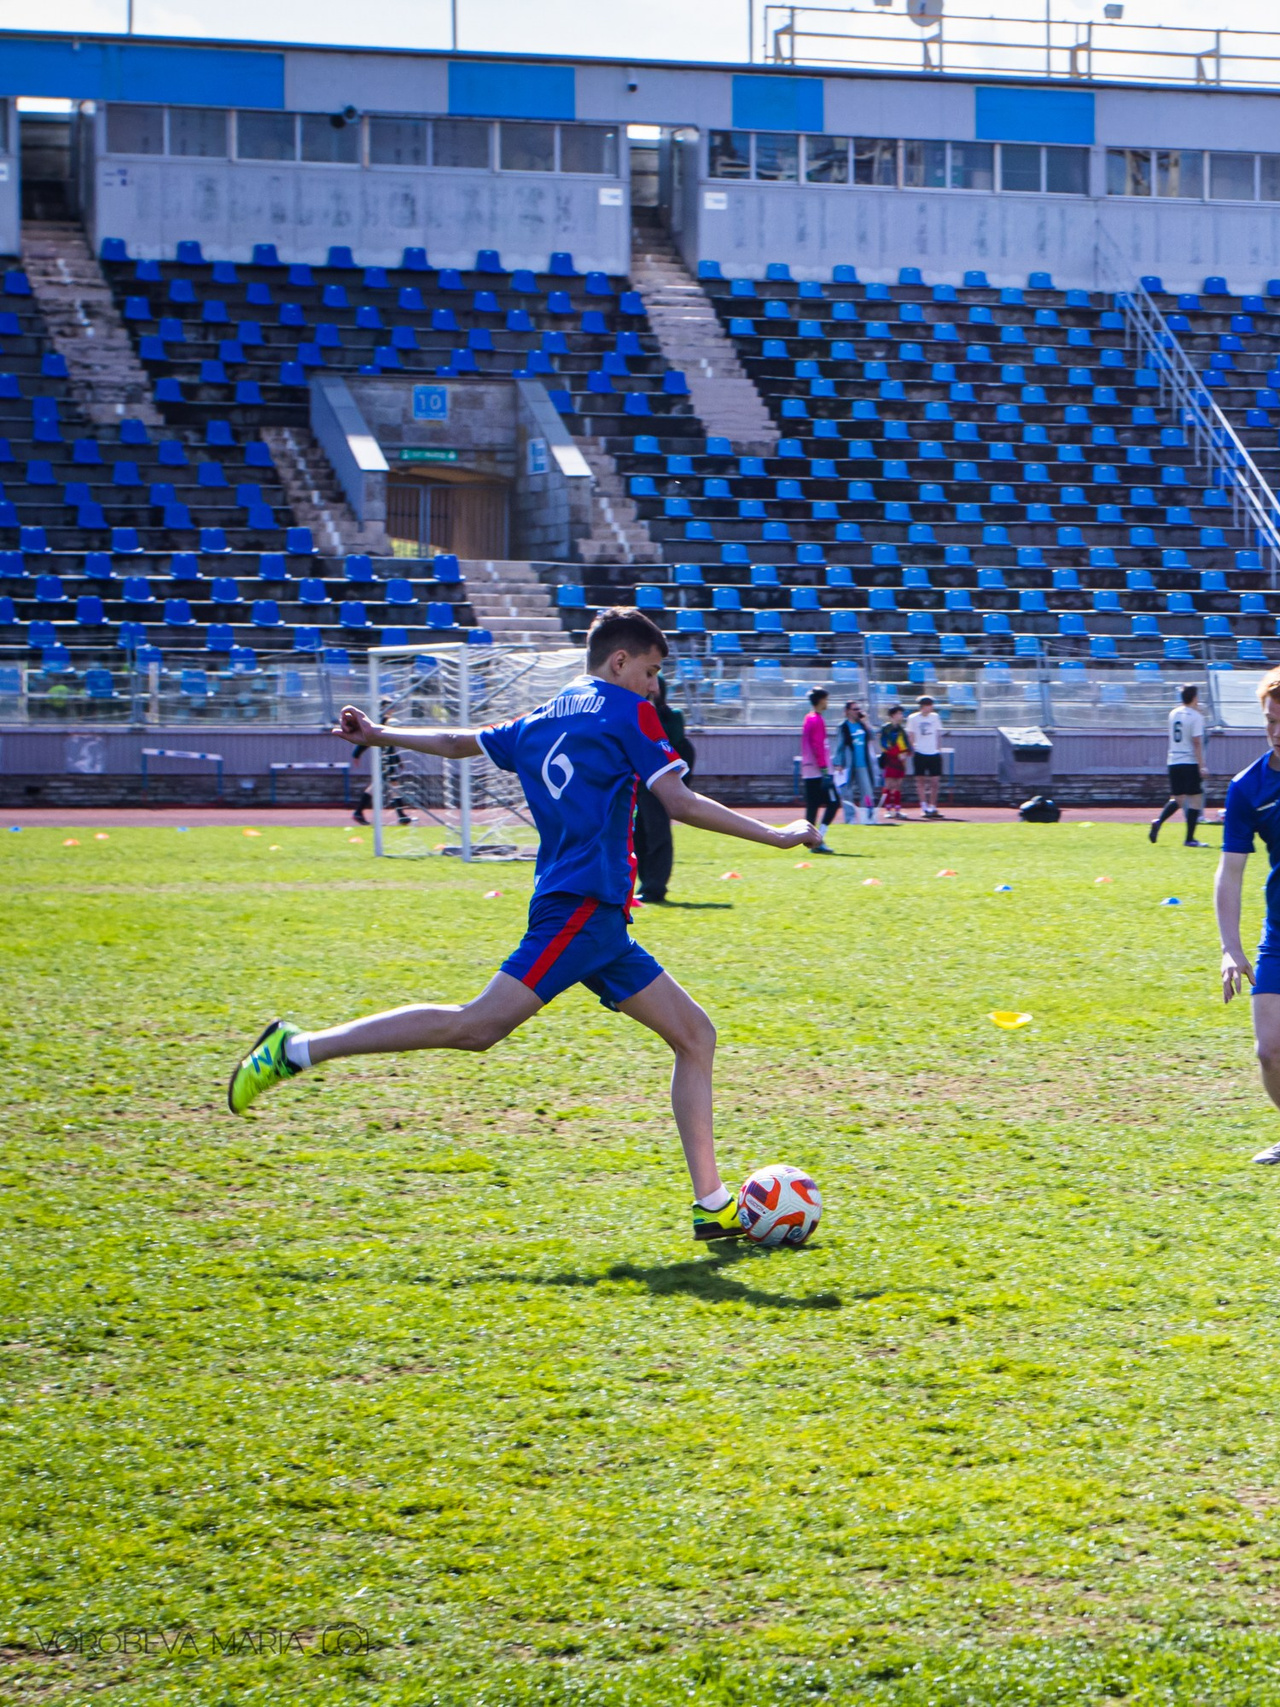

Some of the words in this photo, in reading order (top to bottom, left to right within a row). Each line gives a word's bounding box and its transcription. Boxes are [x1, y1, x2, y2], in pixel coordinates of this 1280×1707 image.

[419, 394, 442, 411] 10
[1174, 721, 1183, 743] 6
[541, 731, 575, 800] 6
